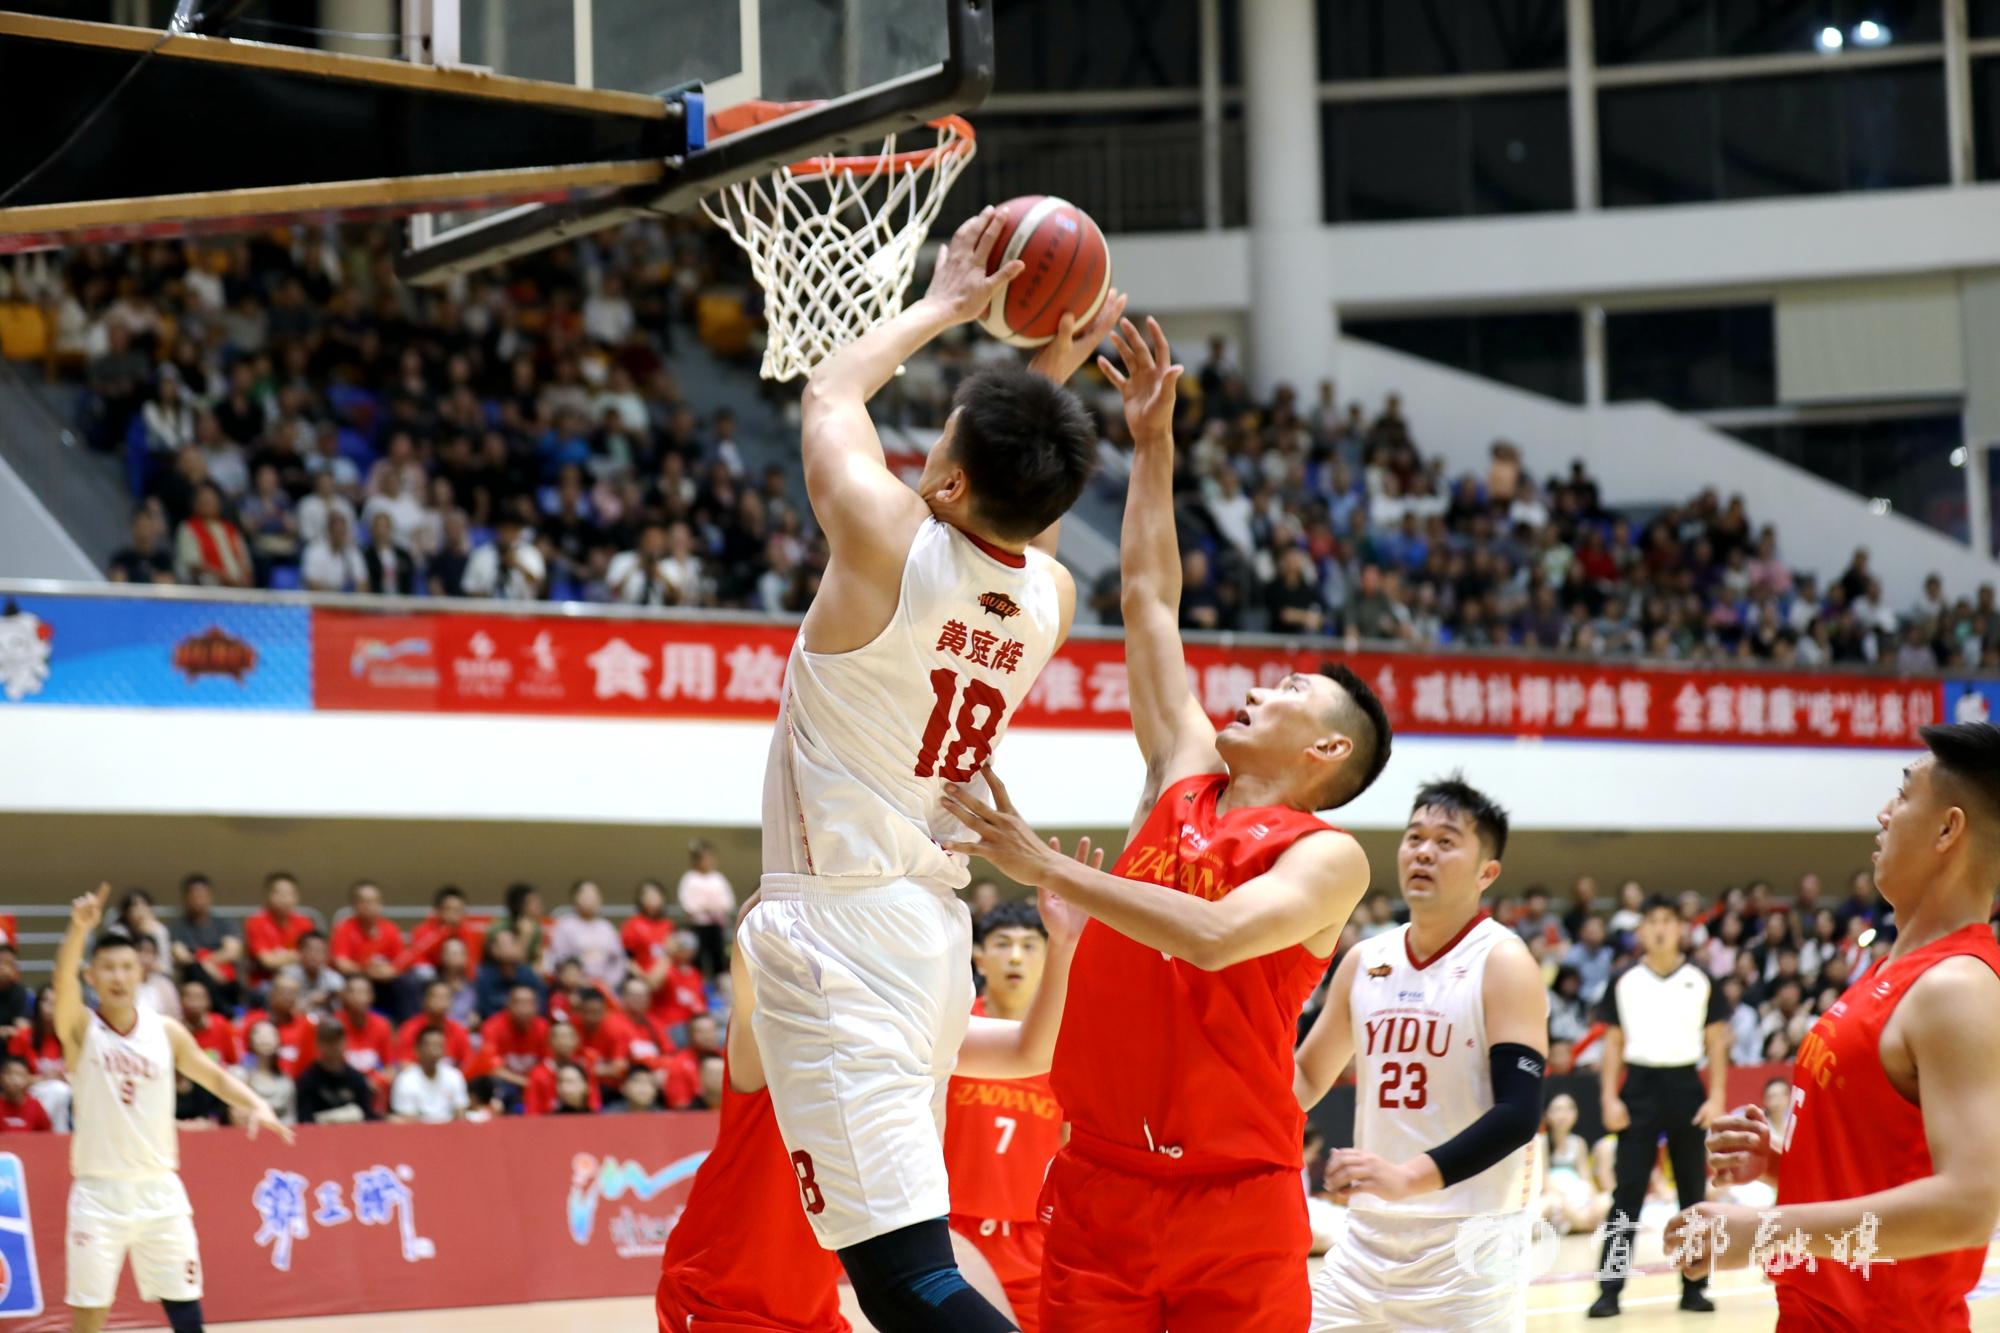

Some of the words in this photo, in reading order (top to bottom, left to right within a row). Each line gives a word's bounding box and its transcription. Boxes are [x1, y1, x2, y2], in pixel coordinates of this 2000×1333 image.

[936, 619, 1025, 675] 黄庭辉
[915, 668, 1007, 782] 18
[1365, 1017, 1452, 1057] YIDU
[1379, 1062, 1427, 1110] 23
[995, 1116, 1016, 1154] 7
